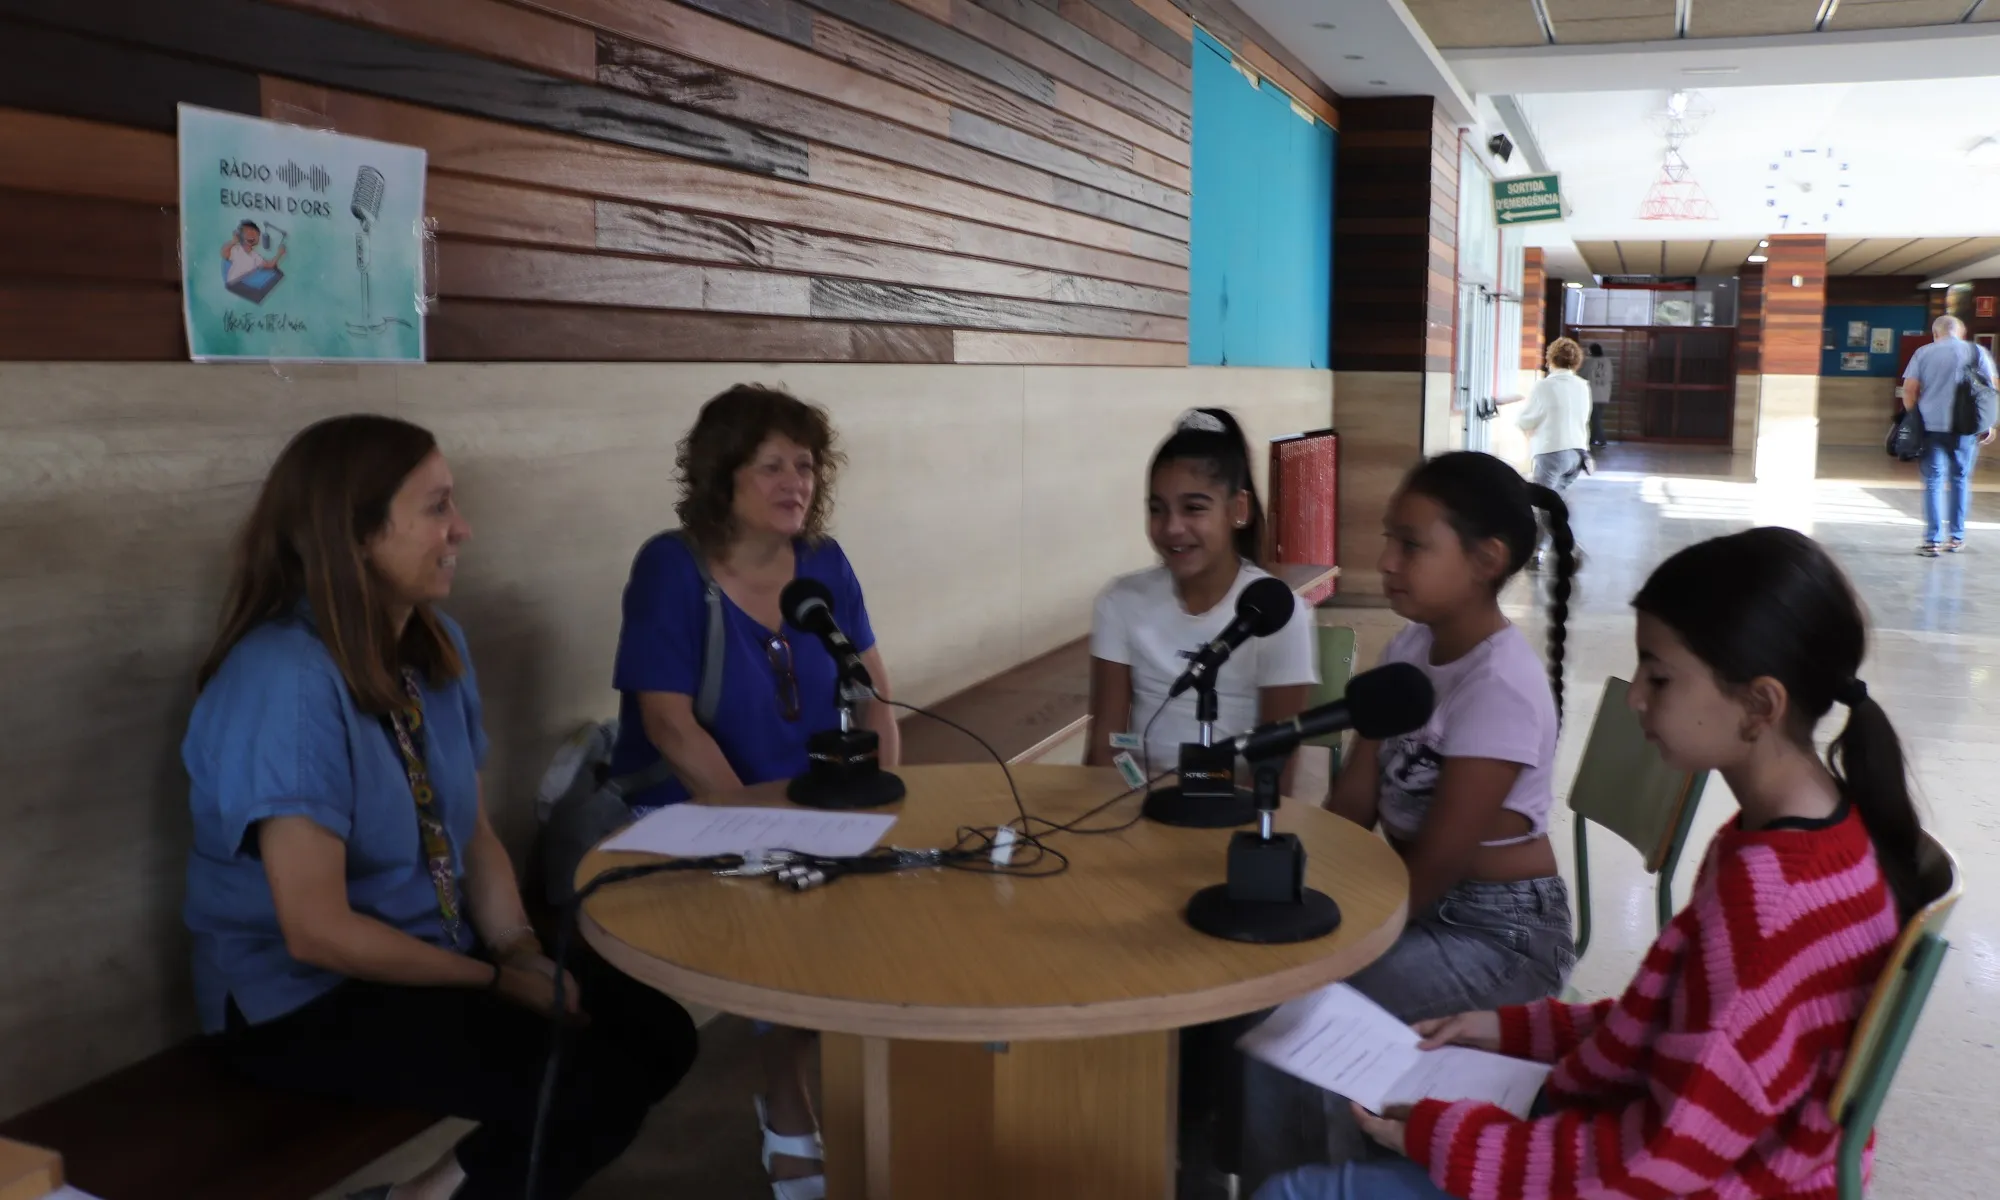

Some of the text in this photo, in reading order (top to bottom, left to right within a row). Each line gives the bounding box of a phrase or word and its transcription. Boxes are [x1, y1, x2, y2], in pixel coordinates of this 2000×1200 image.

[220, 156, 271, 182] RÀDIO
[1507, 180, 1545, 194] SORTIDA
[220, 188, 332, 218] EUGENI D'ORS
[1779, 214, 1789, 229] 7
